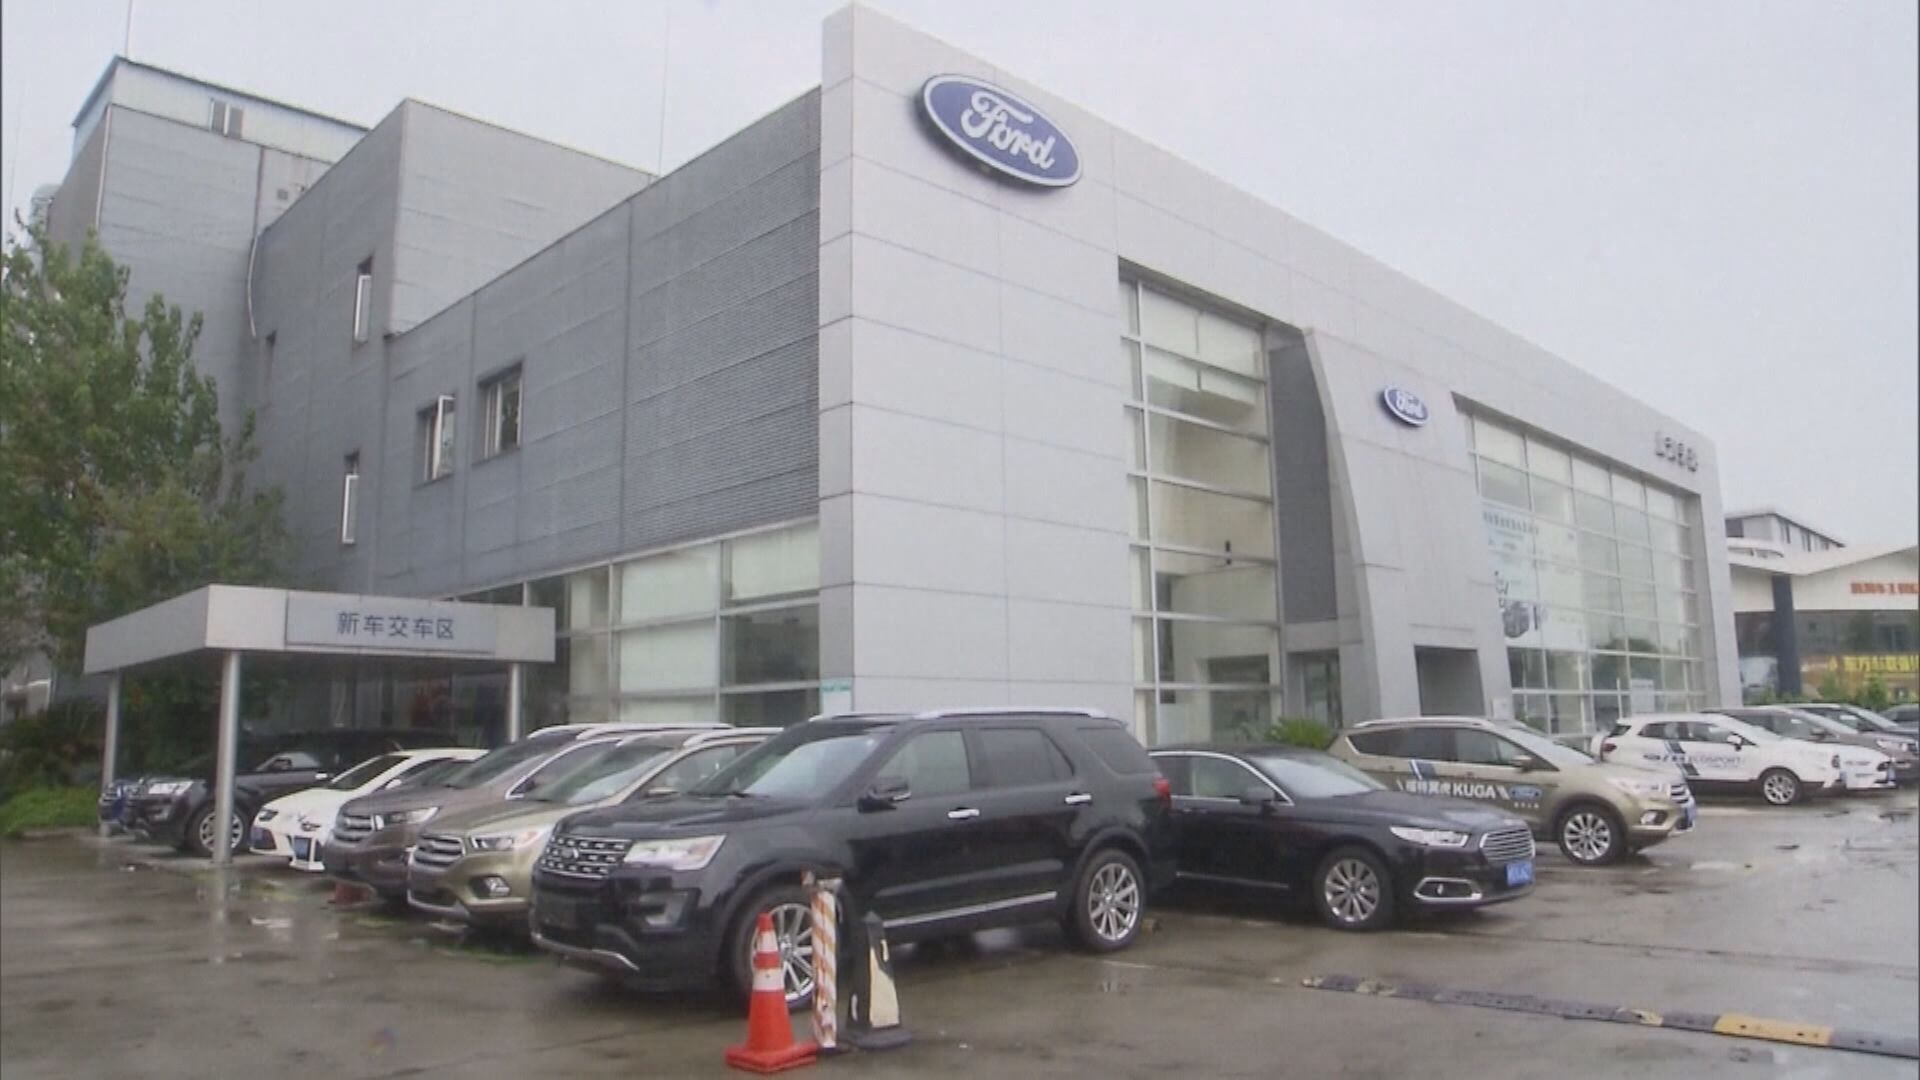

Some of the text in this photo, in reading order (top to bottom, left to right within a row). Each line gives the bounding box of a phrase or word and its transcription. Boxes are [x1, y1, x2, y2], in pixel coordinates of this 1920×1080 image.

[960, 90, 1056, 170] Ford
[336, 611, 455, 640] 新车交车区
[1452, 782, 1497, 799] KUGA
